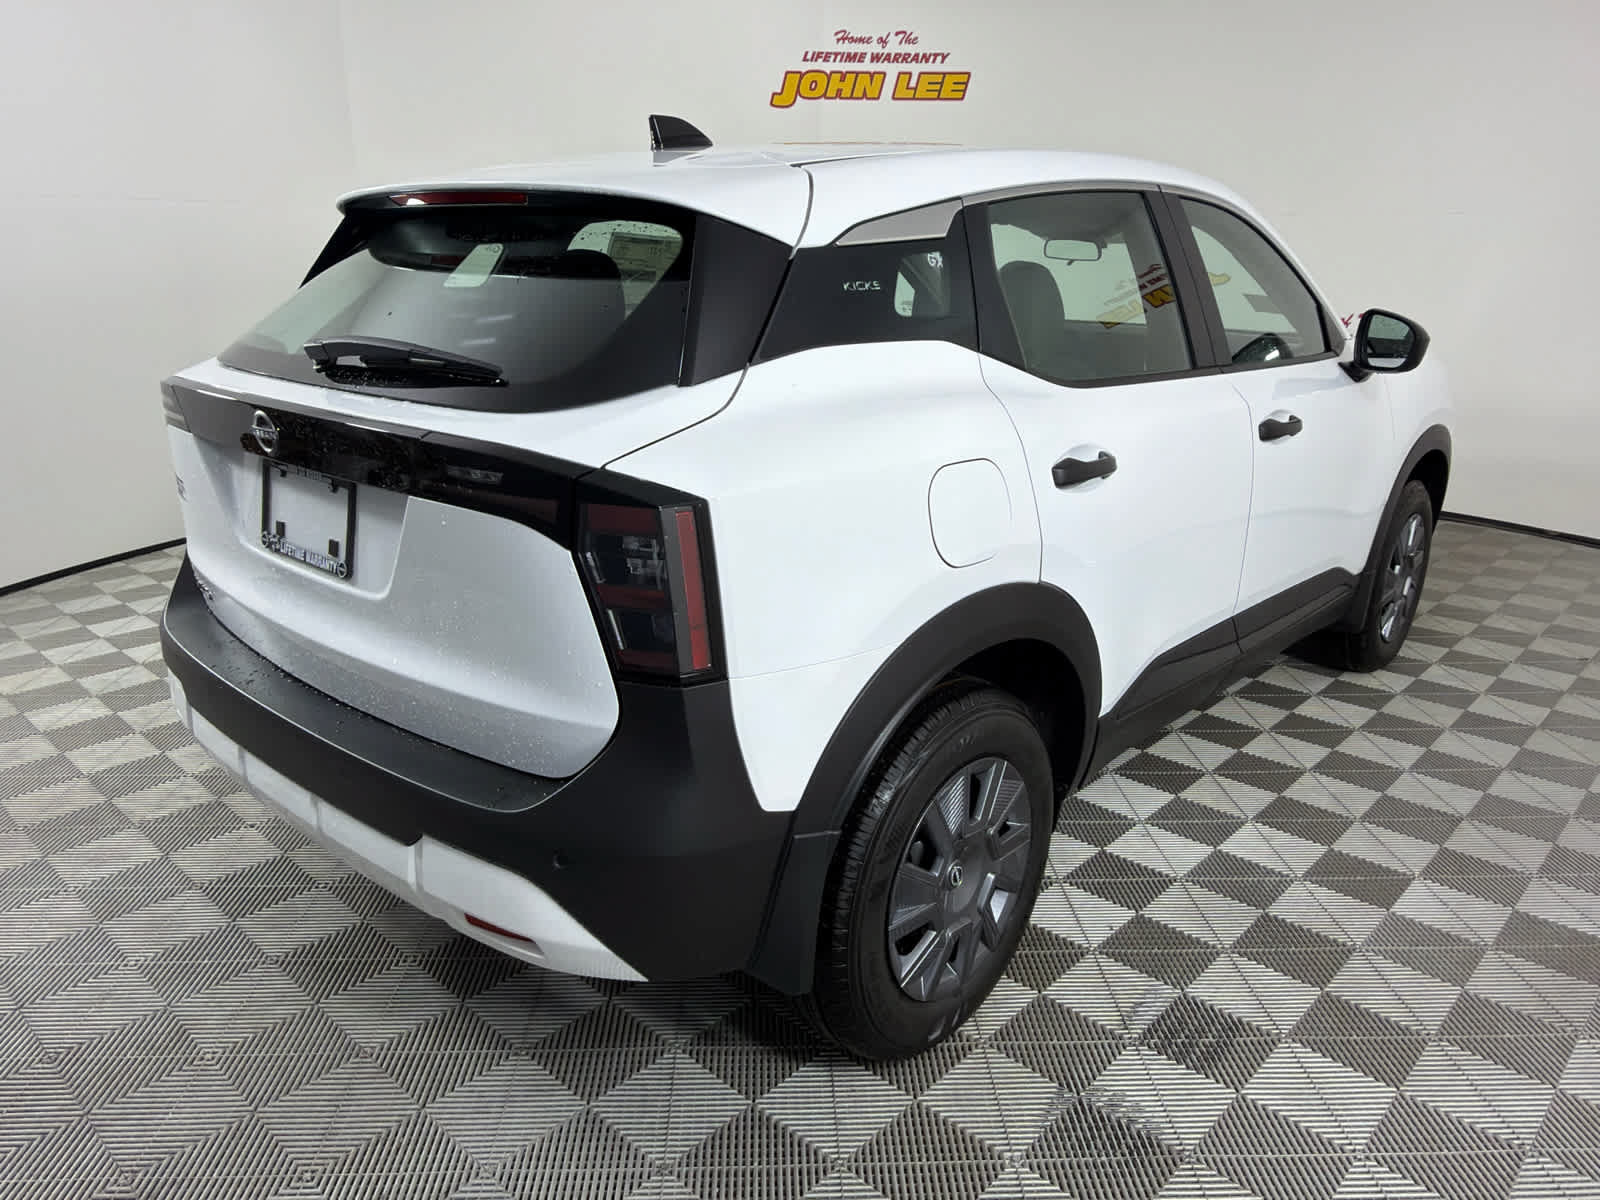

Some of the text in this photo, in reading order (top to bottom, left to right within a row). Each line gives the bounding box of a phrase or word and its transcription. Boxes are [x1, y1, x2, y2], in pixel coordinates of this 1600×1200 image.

[834, 30, 919, 49] Home of The
[802, 51, 951, 64] LIFETIME WARRANTY
[770, 69, 971, 108] JOHN LEE
[843, 280, 881, 292] KICKS
